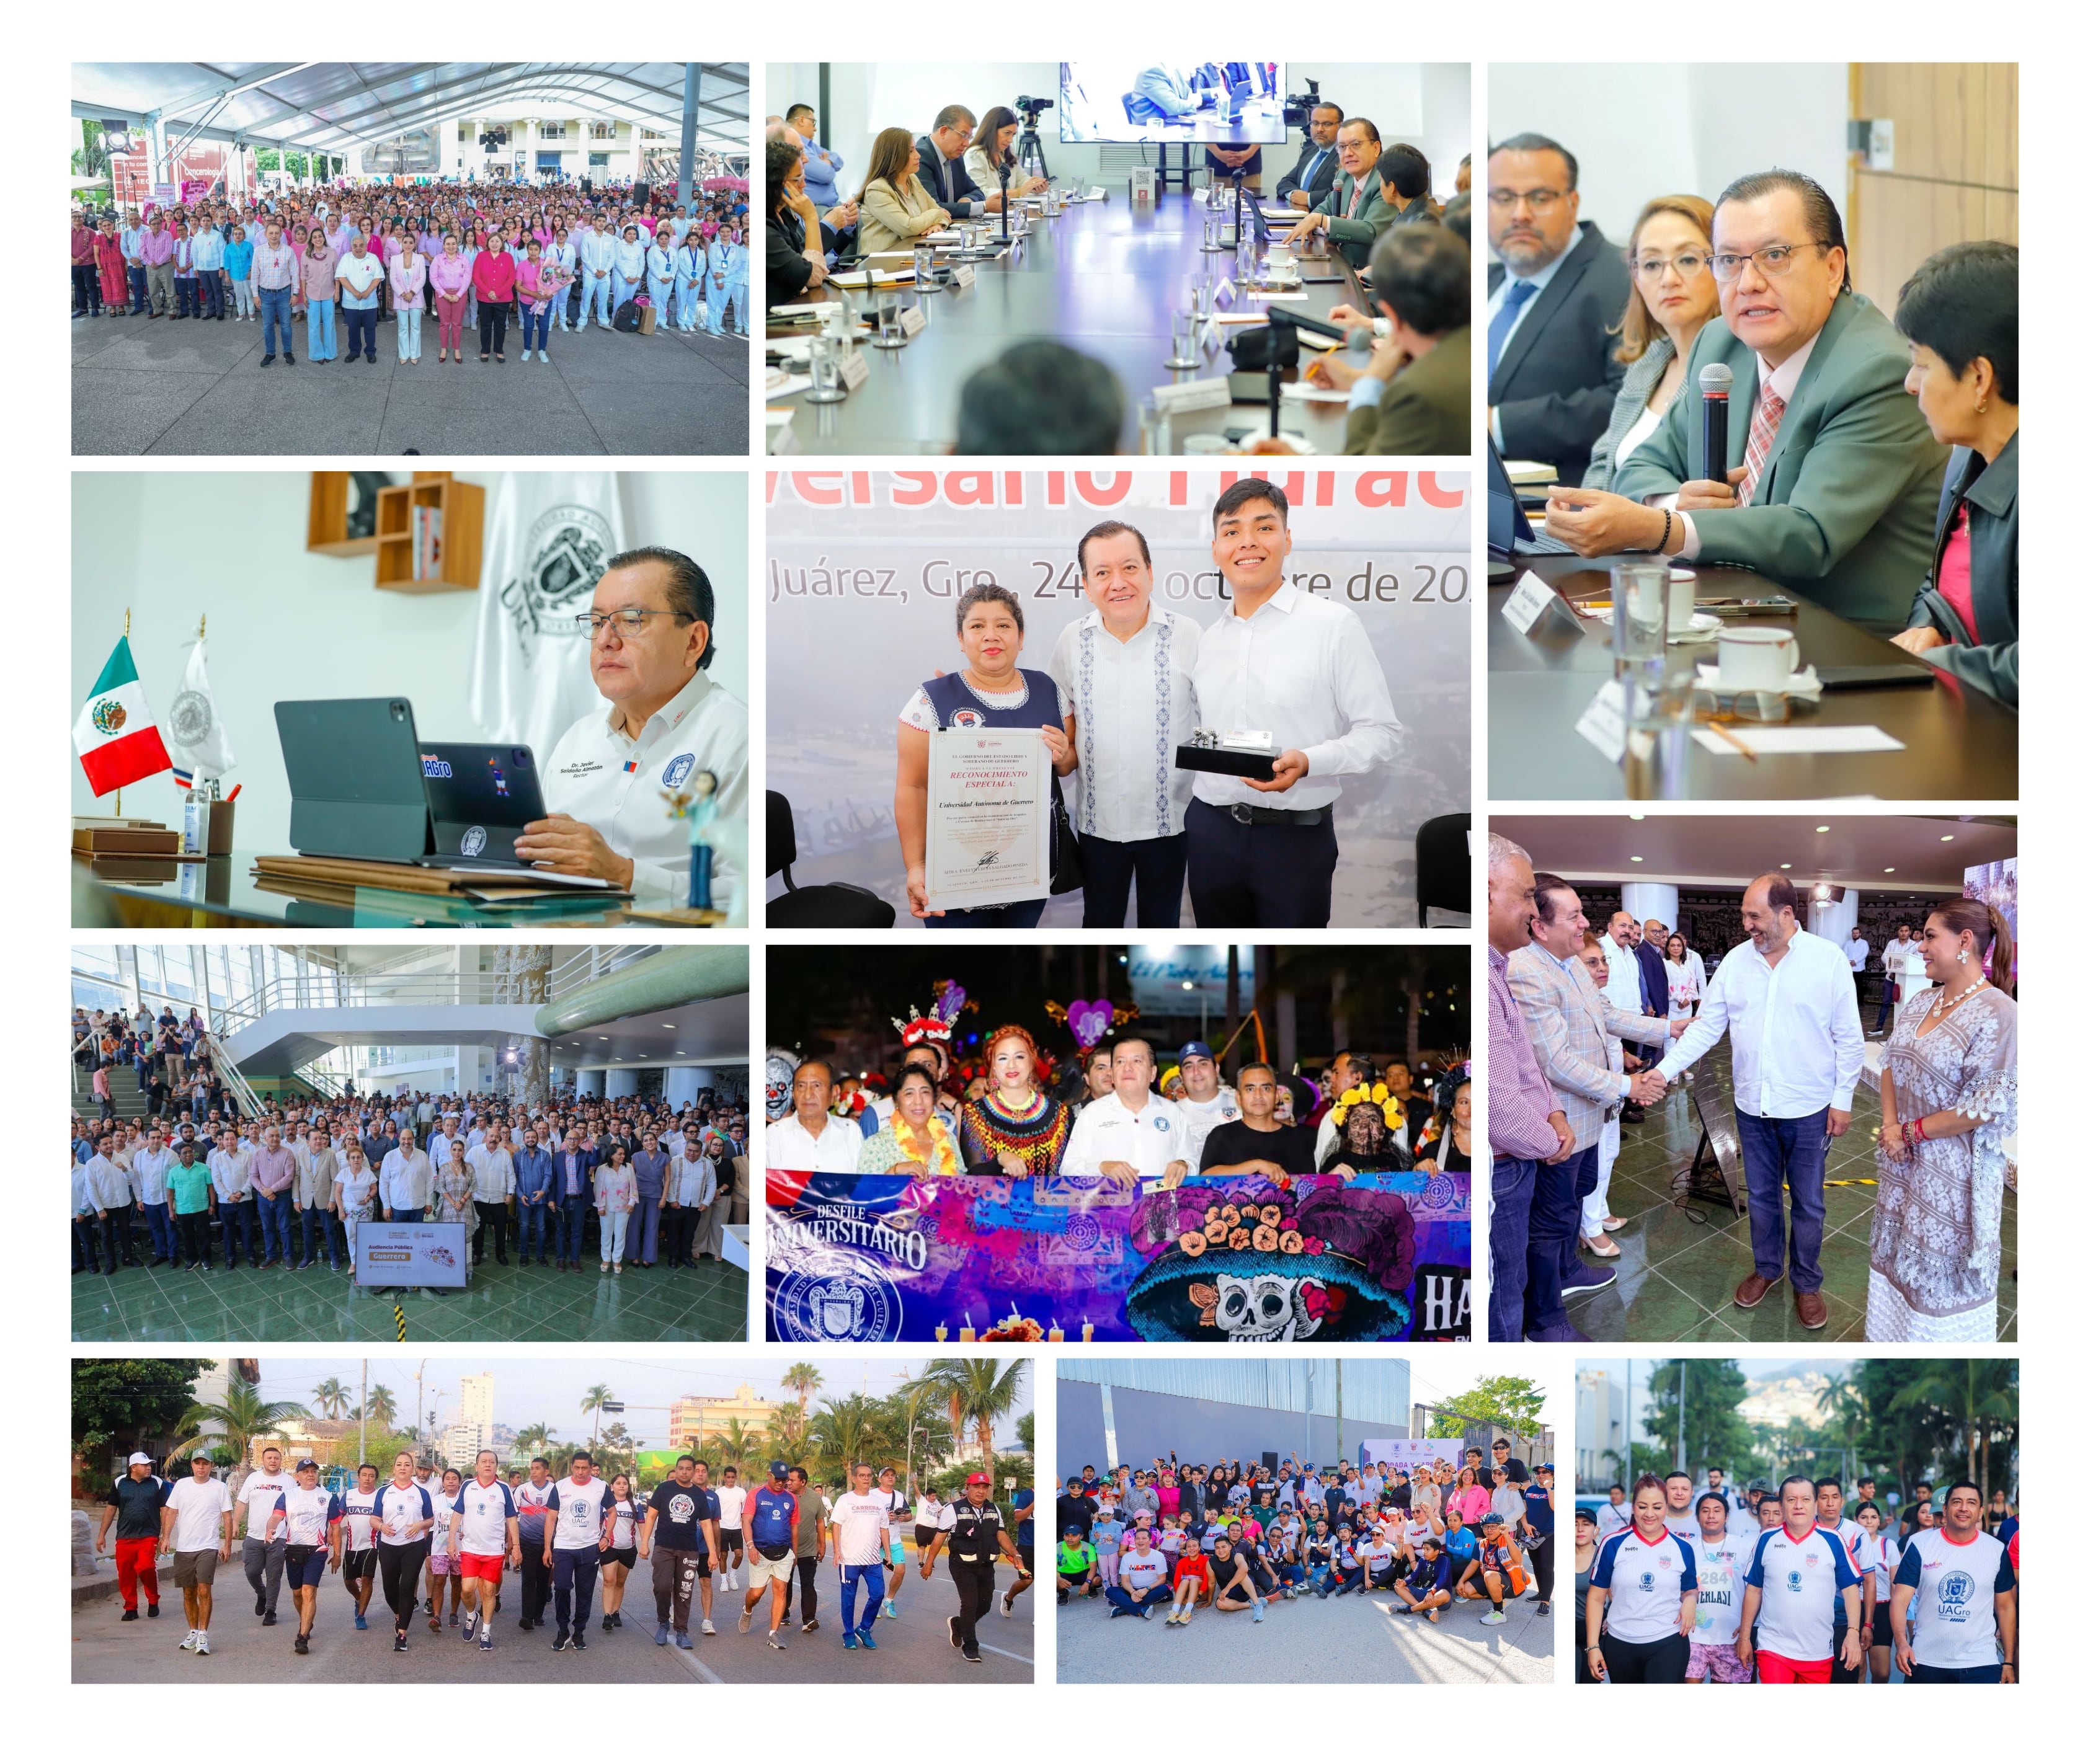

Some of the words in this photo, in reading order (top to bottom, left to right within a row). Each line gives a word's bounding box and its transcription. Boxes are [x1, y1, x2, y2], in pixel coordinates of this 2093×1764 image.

[770, 556, 908, 604] Juárez,
[1031, 561, 1083, 599] 24
[1164, 565, 1331, 601] octre
[1346, 561, 1400, 602] de
[1412, 565, 1471, 603] 20
[958, 707, 986, 719] UNIVERSITARIO
[949, 771, 1028, 779] RECONOCIMIENTO
[817, 1204, 866, 1220] DESFILE
[868, 1300, 885, 1342] GUERRER
[1700, 1572, 1728, 1585] 284
[1697, 1590, 1731, 1607] VERLAST
[1938, 1605, 1971, 1616] UAGro
